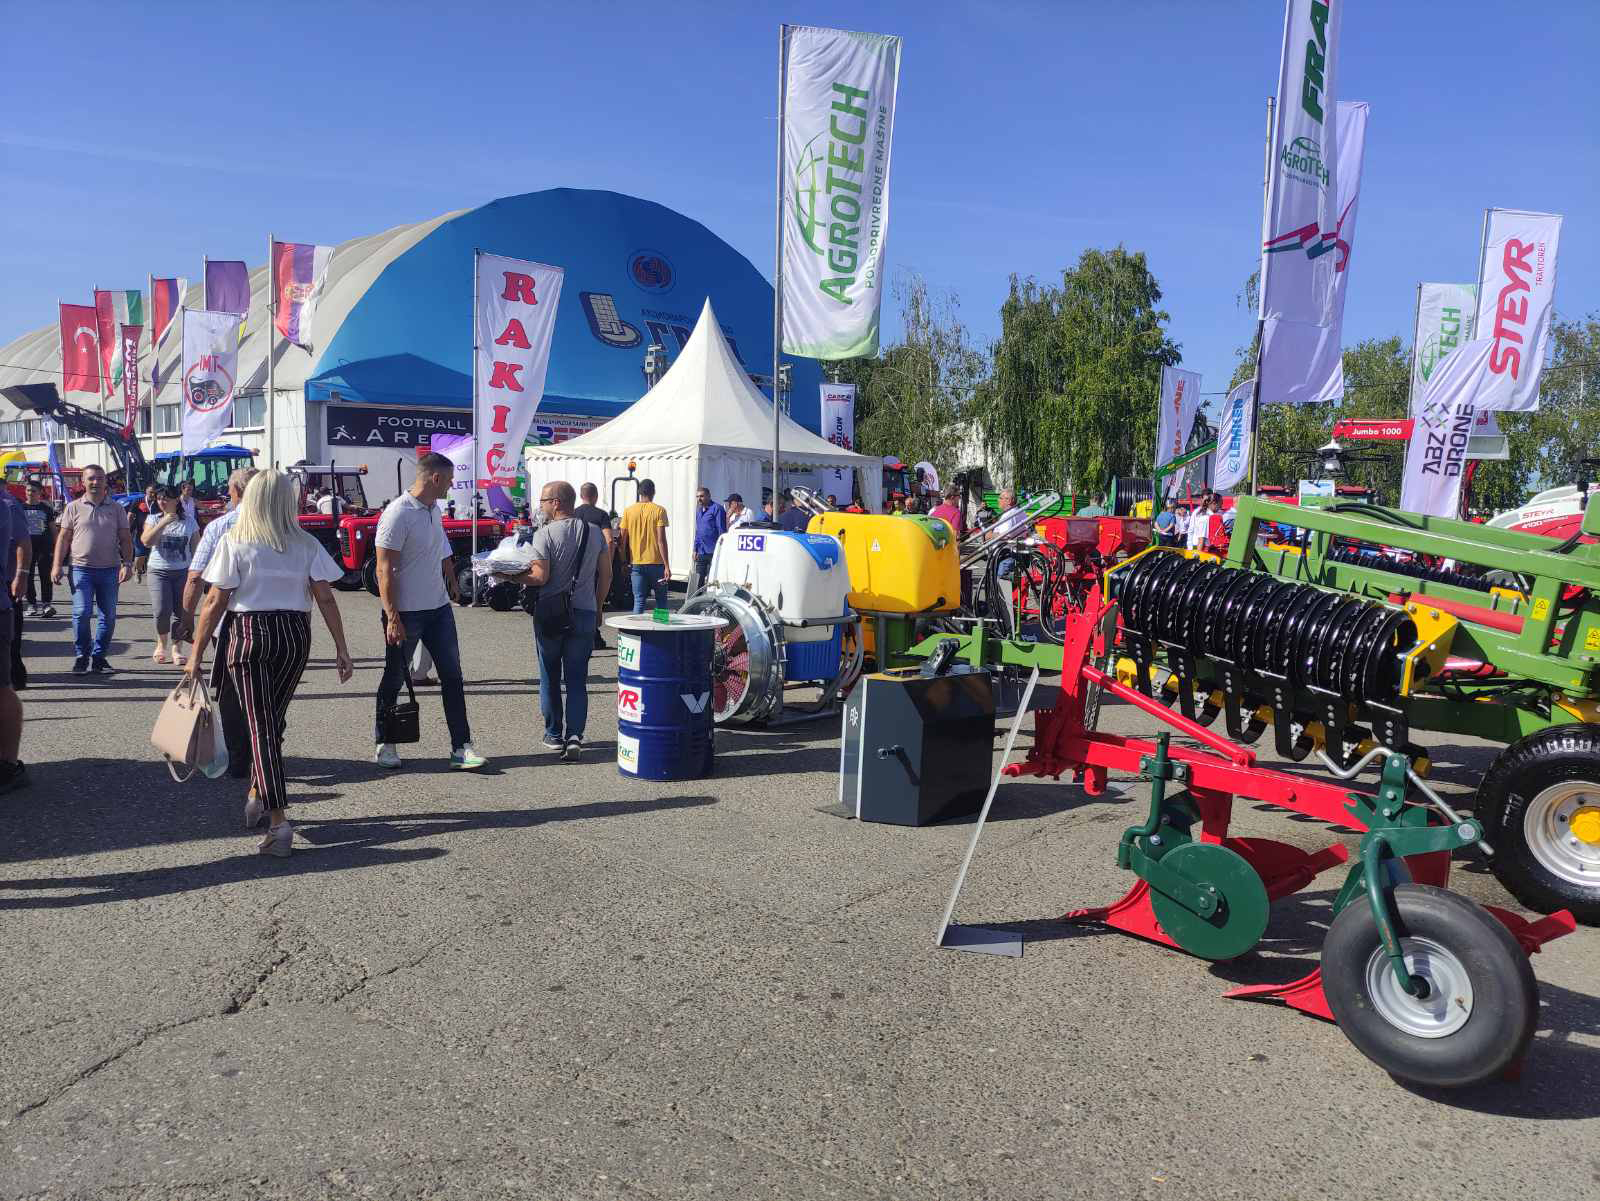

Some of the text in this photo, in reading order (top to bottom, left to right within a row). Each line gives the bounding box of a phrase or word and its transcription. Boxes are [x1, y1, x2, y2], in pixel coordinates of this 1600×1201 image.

[874, 104, 888, 162] MAŠINE
[1280, 144, 1330, 187] AGROTEH
[819, 81, 870, 305] AGROTECH
[1439, 307, 1462, 359] TECH
[1488, 238, 1535, 381] STEYR
[366, 428, 430, 444] ARE
[377, 416, 467, 430] FOOTBALL
[1230, 398, 1244, 458] LEMKEN
[1351, 427, 1402, 435] Jumbo 1000
[1444, 403, 1475, 477] DRONE
[1422, 431, 1447, 476] ABZ
[738, 535, 763, 551] HSC
